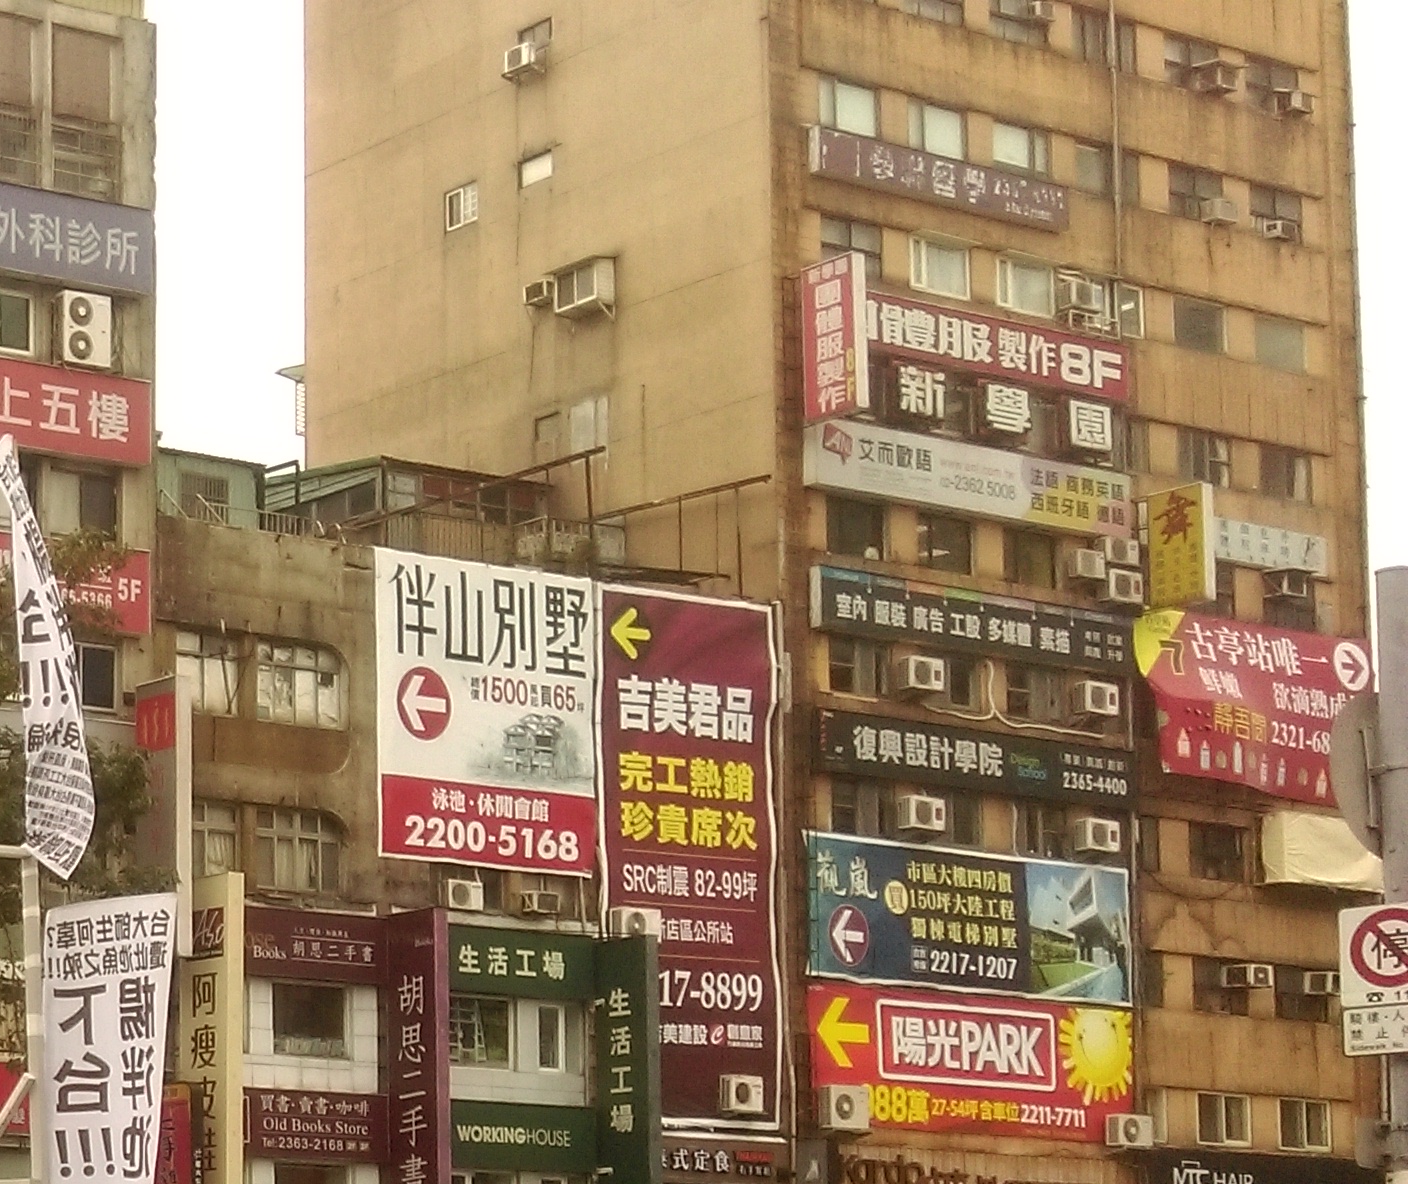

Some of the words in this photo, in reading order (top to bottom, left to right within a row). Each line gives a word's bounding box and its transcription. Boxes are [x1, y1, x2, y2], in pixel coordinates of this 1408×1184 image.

[389, 563, 589, 679] 伴山別墅
[1185, 621, 1329, 677] 古亭站唯一
[616, 674, 754, 744] 吉美君品
[852, 724, 1004, 779] 復興設計學院
[617, 750, 755, 804] 完工熱銷
[1062, 771, 1128, 797] 2365-4400
[404, 815, 580, 863] 2200-5168
[619, 799, 758, 851] 珍貴席次
[693, 869, 758, 902] 82-99坪
[252, 945, 287, 960] Books
[458, 944, 566, 981] 生活工場
[930, 950, 1018, 980] 2217-1207
[608, 987, 635, 1134] 生活工場
[890, 1014, 1045, 1077] 陽光PARK
[262, 1115, 288, 1132] Old
[291, 1116, 332, 1134] Books
[335, 1119, 369, 1136] Store
[456, 1122, 571, 1148] WORKINGHOUSE
[1020, 1103, 1087, 1129] 2211-7711
